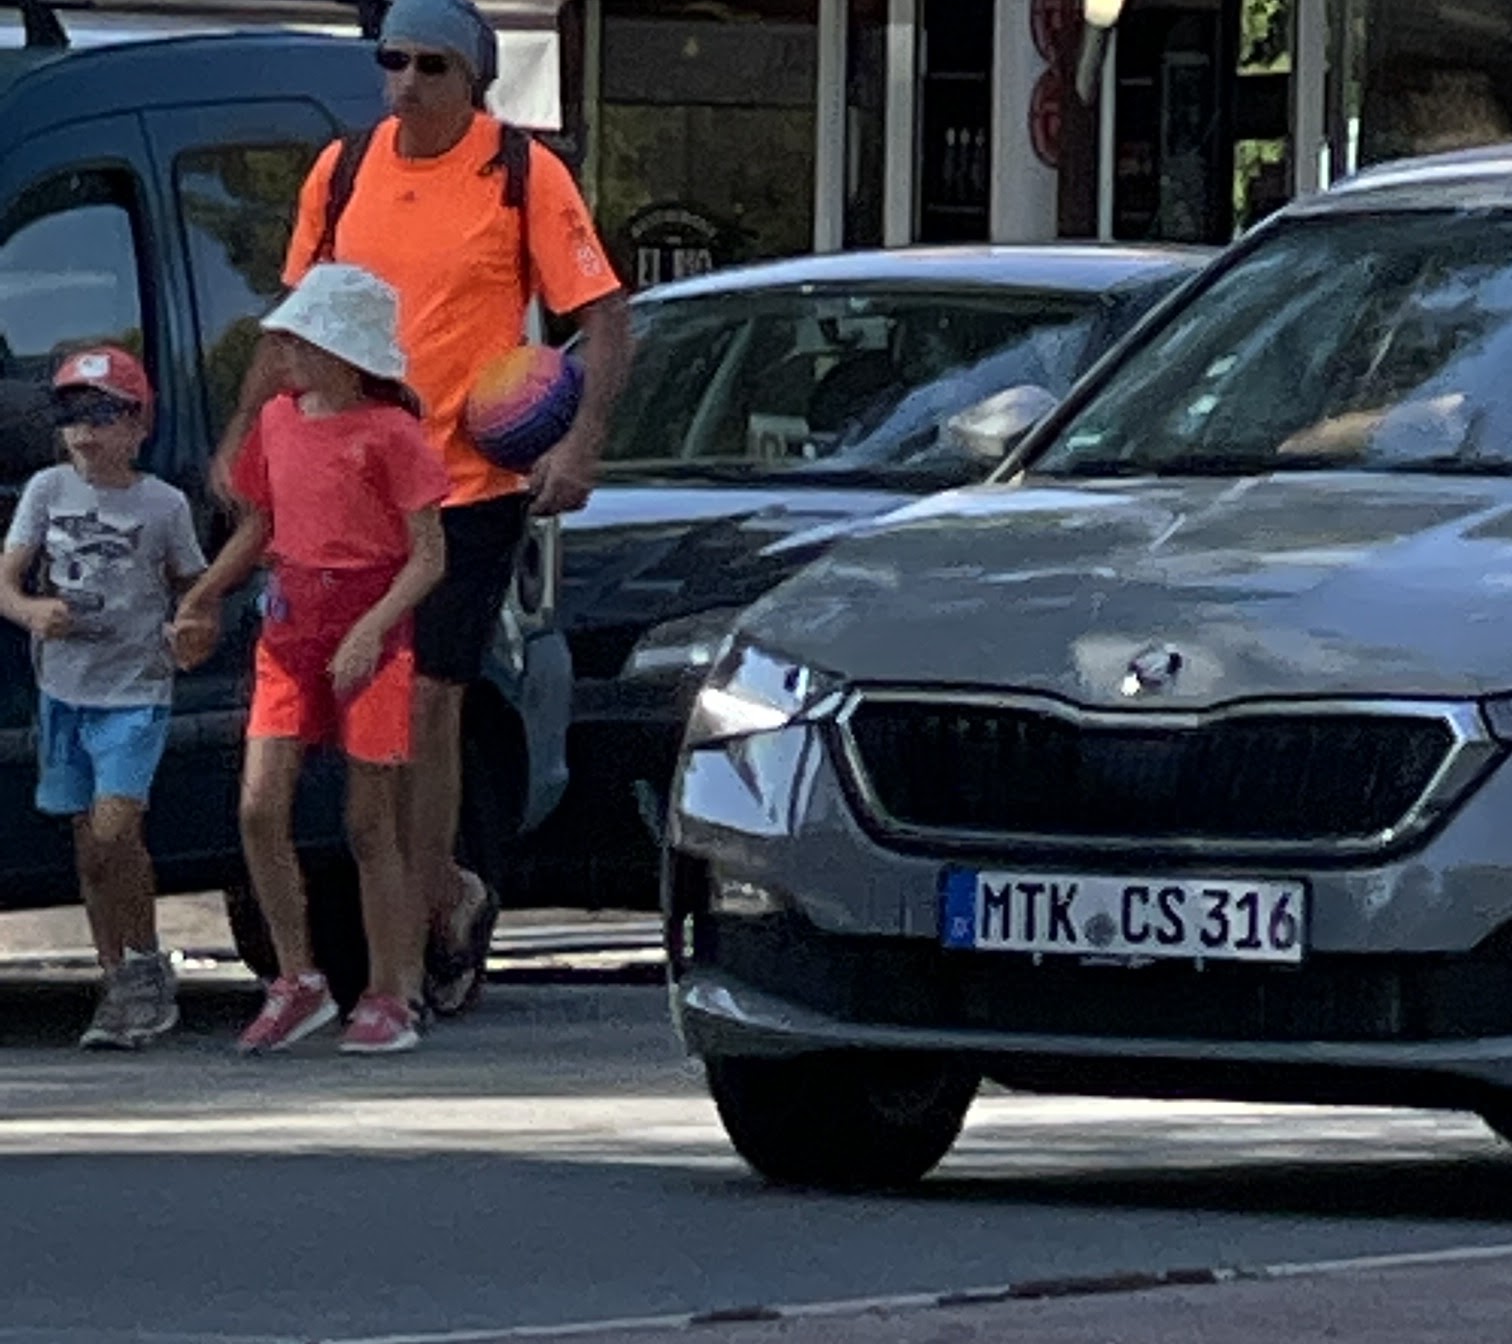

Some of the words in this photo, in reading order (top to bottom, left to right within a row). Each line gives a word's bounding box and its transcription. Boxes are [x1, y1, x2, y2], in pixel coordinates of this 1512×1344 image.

[980, 882, 1078, 943] MTK
[1120, 885, 1187, 945] CS
[1199, 888, 1298, 952] 316
